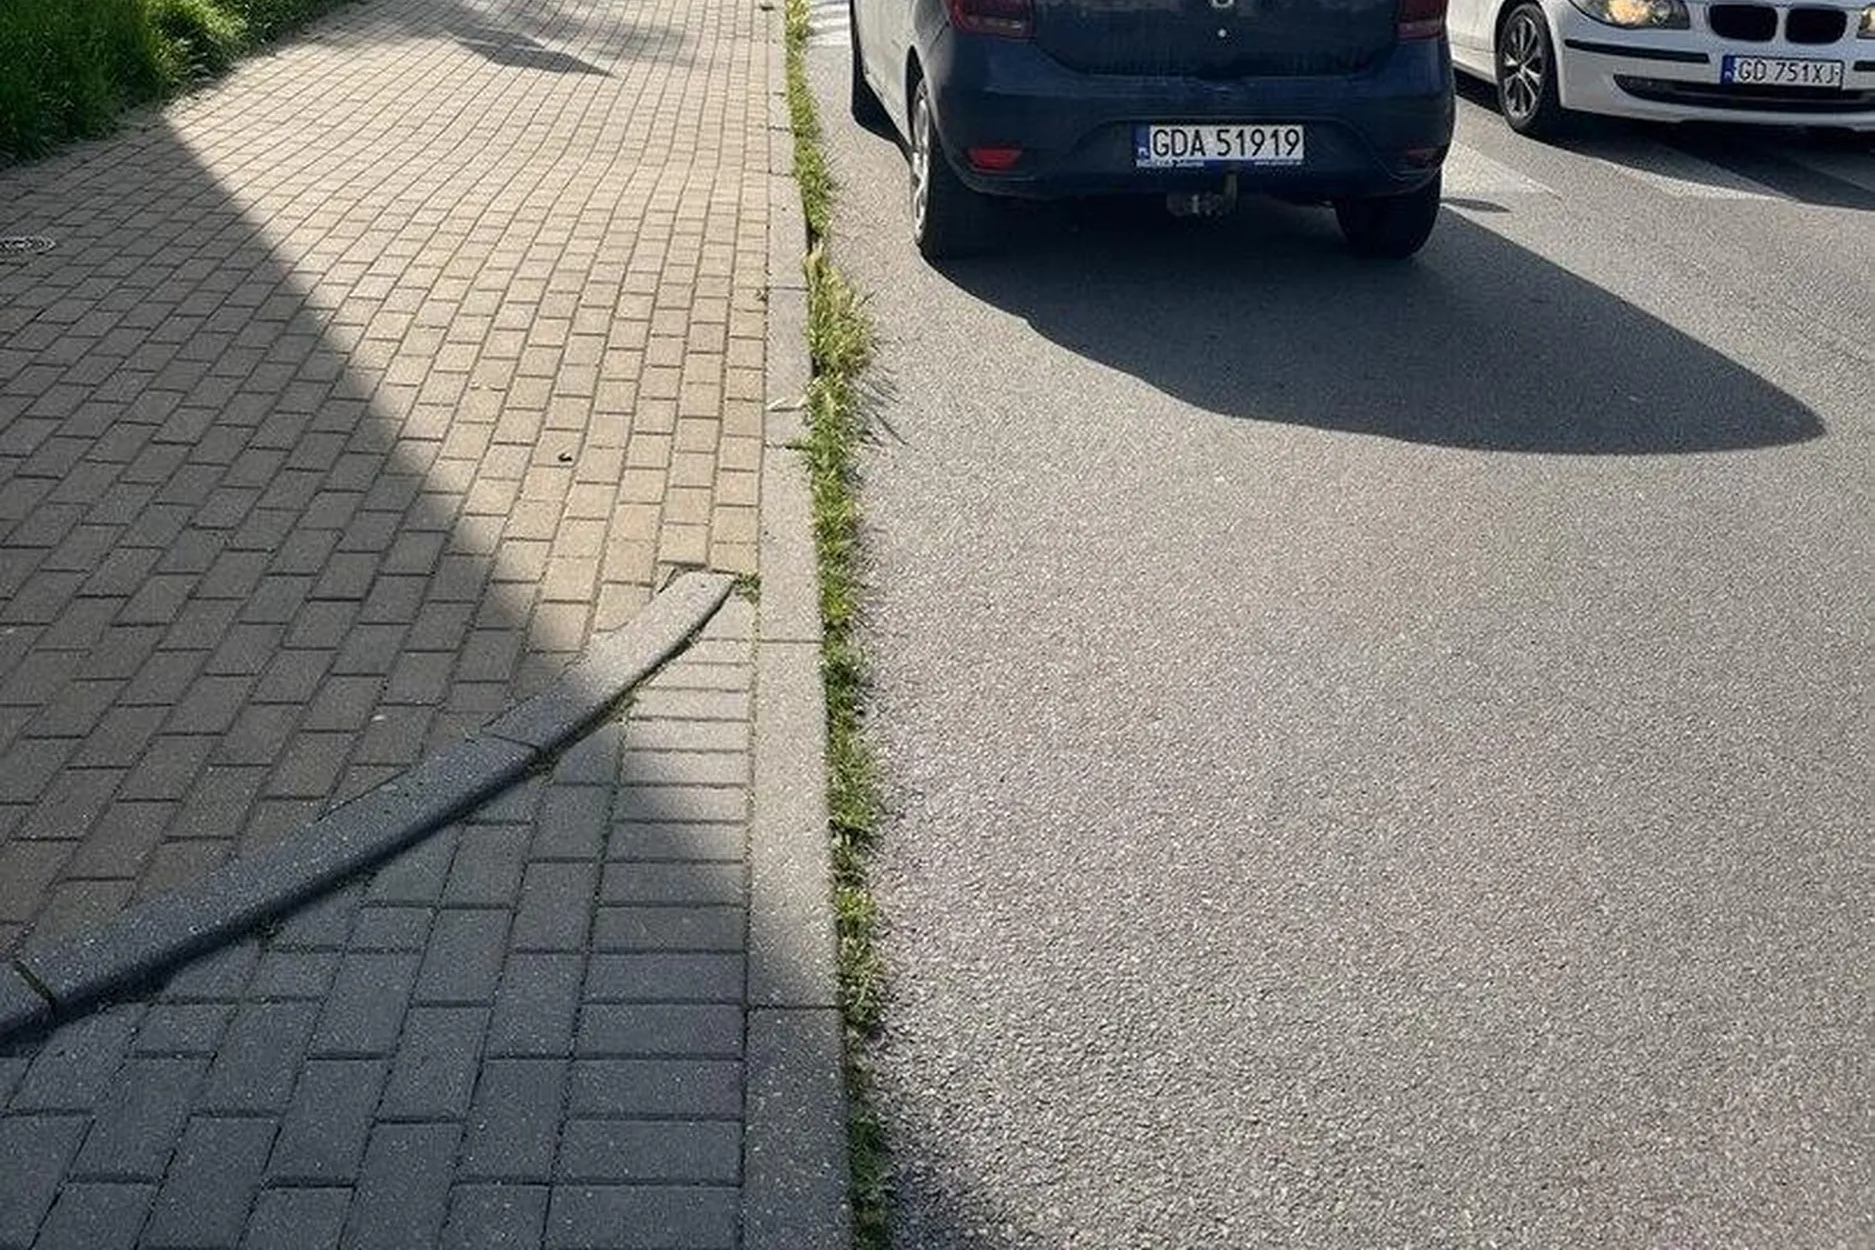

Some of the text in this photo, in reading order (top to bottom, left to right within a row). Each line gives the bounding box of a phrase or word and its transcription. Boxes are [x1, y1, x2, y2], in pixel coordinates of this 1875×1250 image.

[1739, 60, 1767, 82] GD
[1774, 62, 1834, 84] 751XJ
[1152, 129, 1300, 157] GDA 51919
